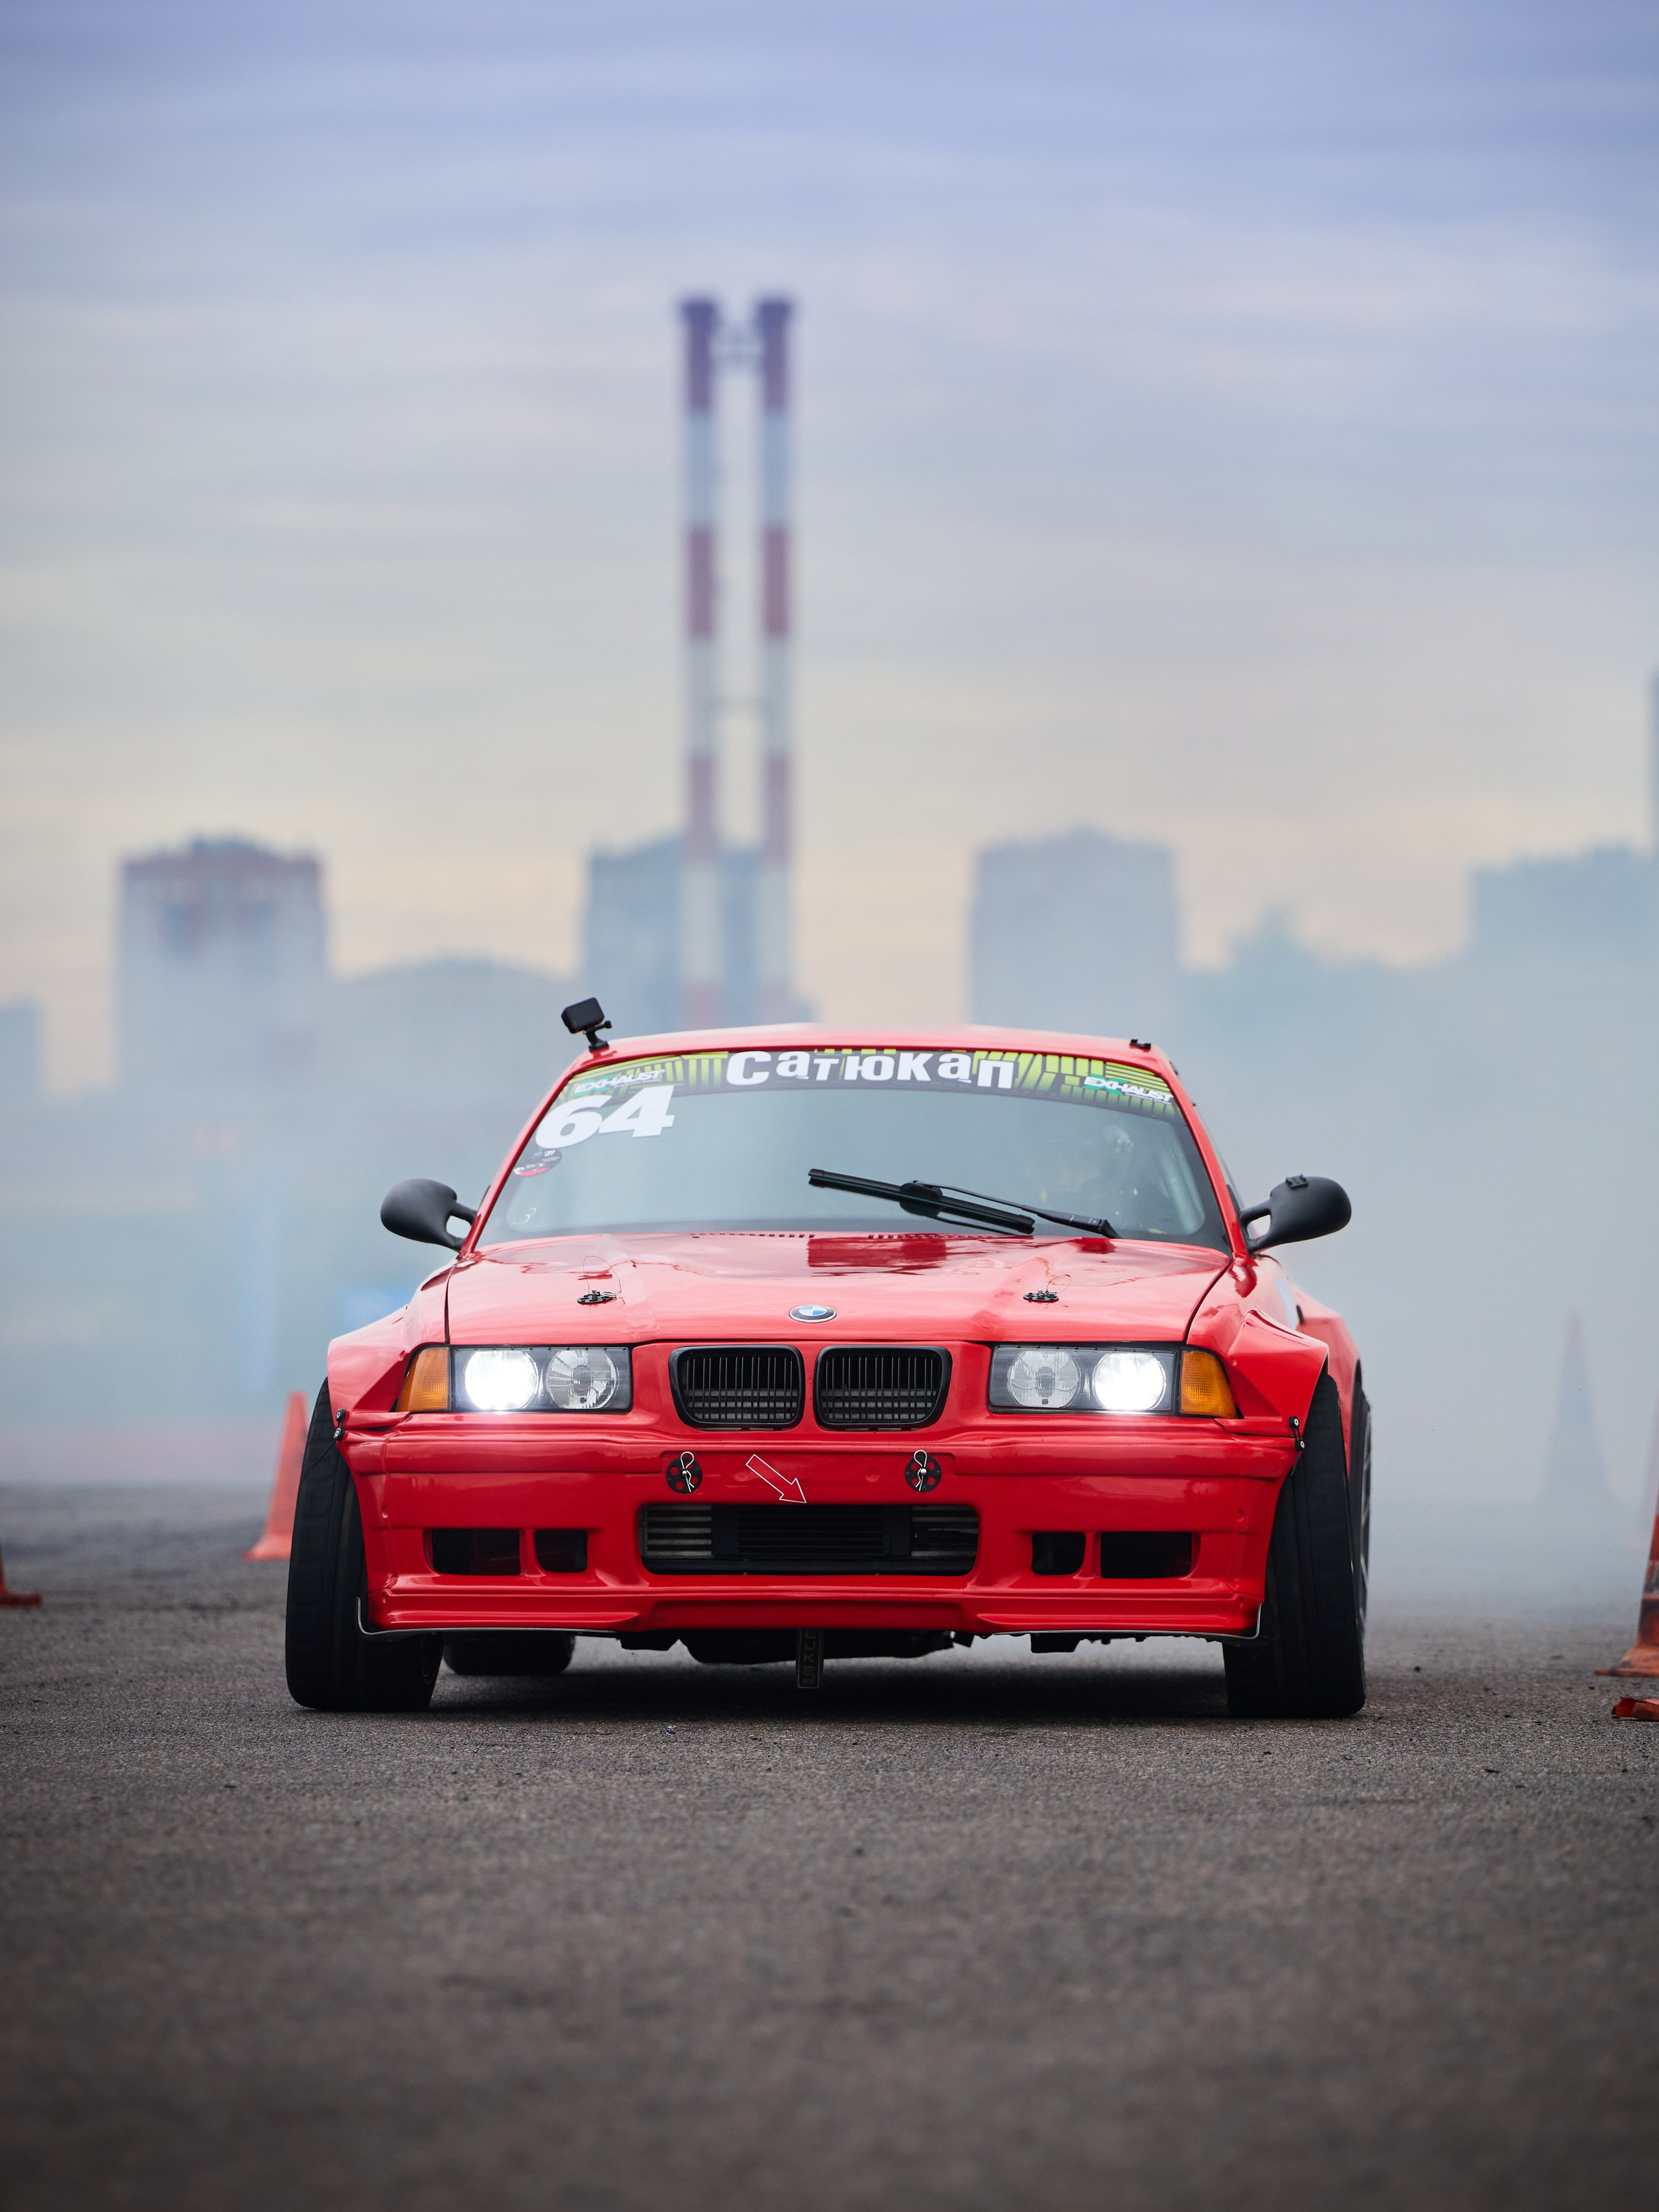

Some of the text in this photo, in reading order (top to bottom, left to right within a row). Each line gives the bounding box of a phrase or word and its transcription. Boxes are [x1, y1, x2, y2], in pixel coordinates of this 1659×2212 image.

[574, 1069, 666, 1094] EXHAUST
[1084, 1077, 1174, 1102] EXHAUST
[535, 1084, 675, 1149] 64
